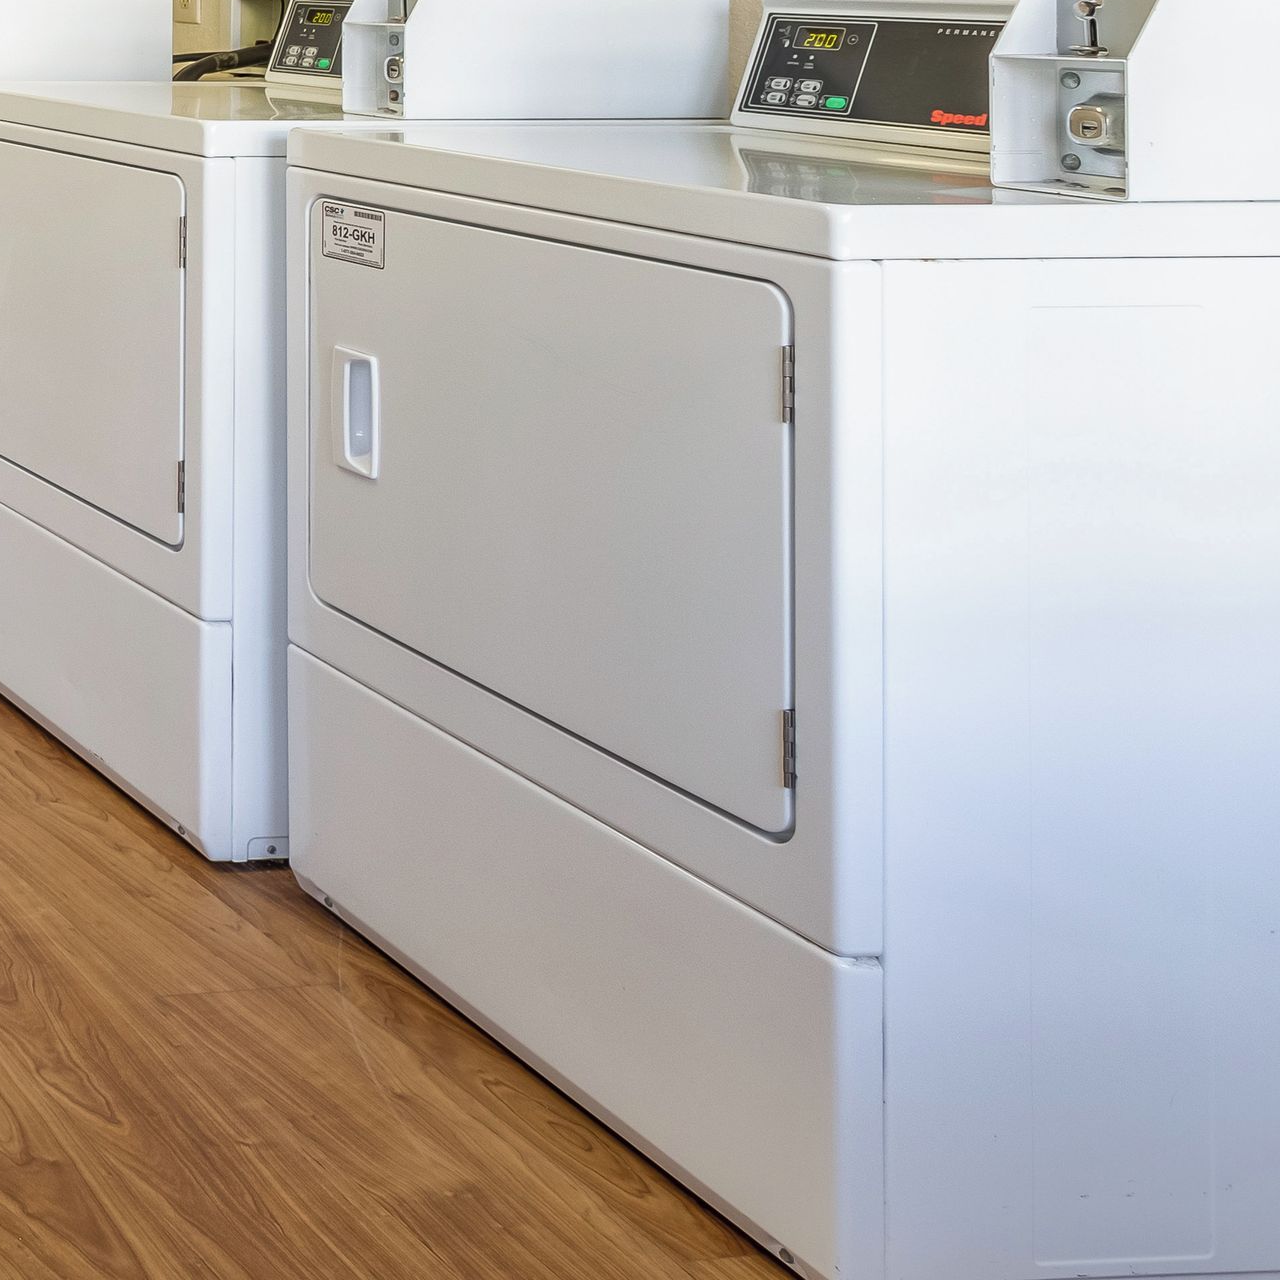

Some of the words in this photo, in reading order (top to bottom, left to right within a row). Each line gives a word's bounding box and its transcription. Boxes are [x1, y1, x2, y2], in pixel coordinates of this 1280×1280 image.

[930, 109, 988, 126] Speed
[324, 205, 340, 214] CSC
[332, 224, 375, 245] 812-GKH
